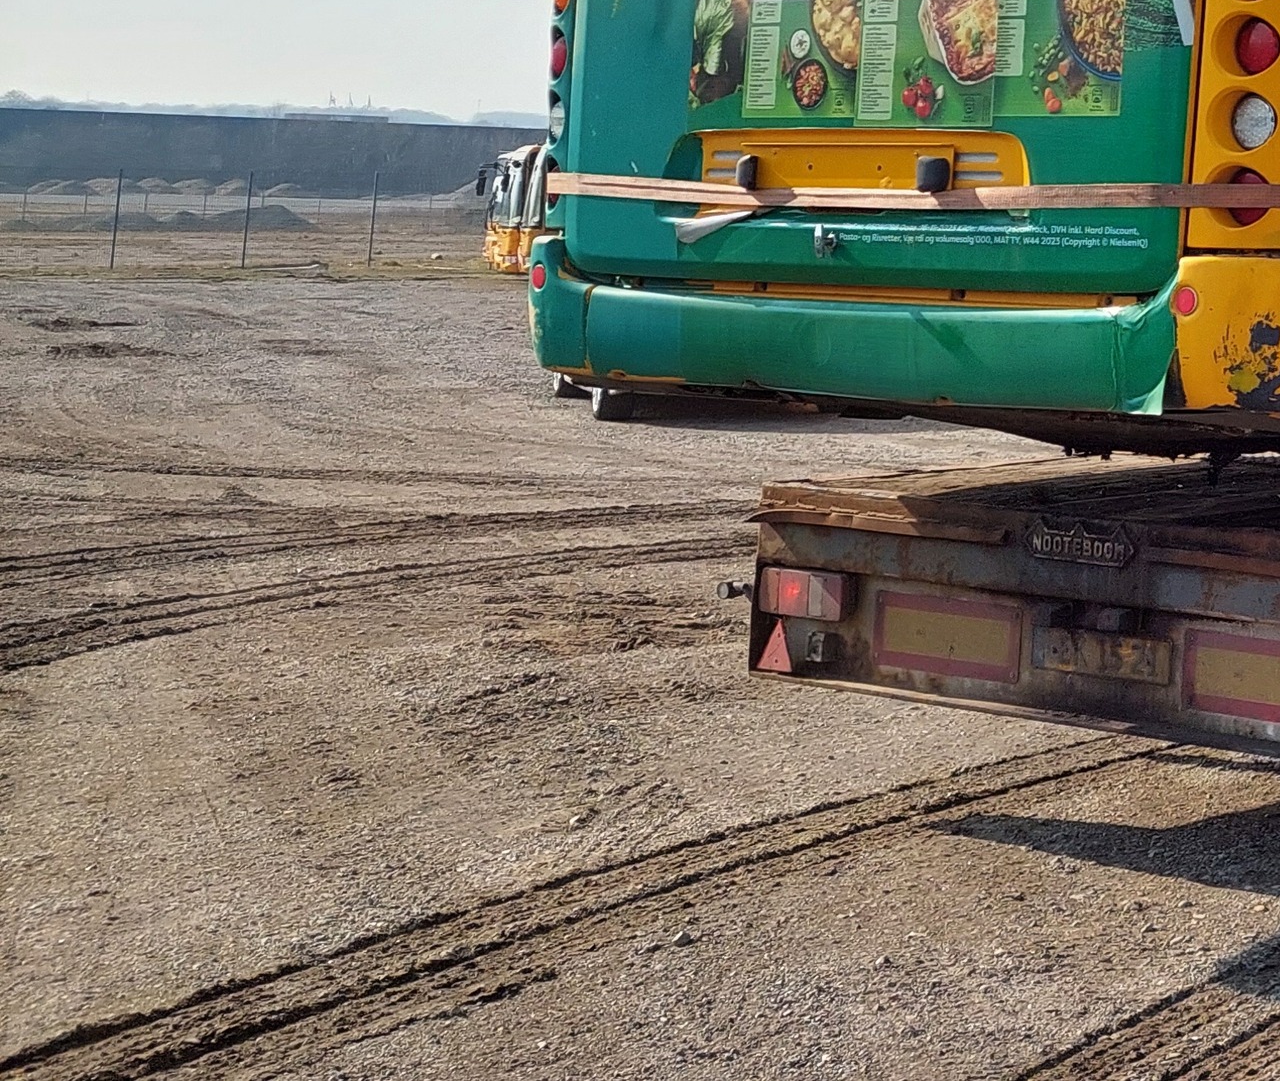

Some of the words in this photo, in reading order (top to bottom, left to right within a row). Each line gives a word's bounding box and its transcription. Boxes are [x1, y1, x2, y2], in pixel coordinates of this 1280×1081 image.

[1050, 225, 1067, 234] DVH
[1084, 225, 1103, 235] Hard
[1104, 226, 1140, 236] Discount,
[839, 233, 861, 241] Pasta-
[862, 235, 871, 243] og
[924, 235, 934, 245] og
[1022, 236, 1040, 245] W44
[1041, 237, 1061, 245] 2023
[1061, 237, 1101, 248] (Copyright
[1109, 238, 1148, 249] NielsenIQ)
